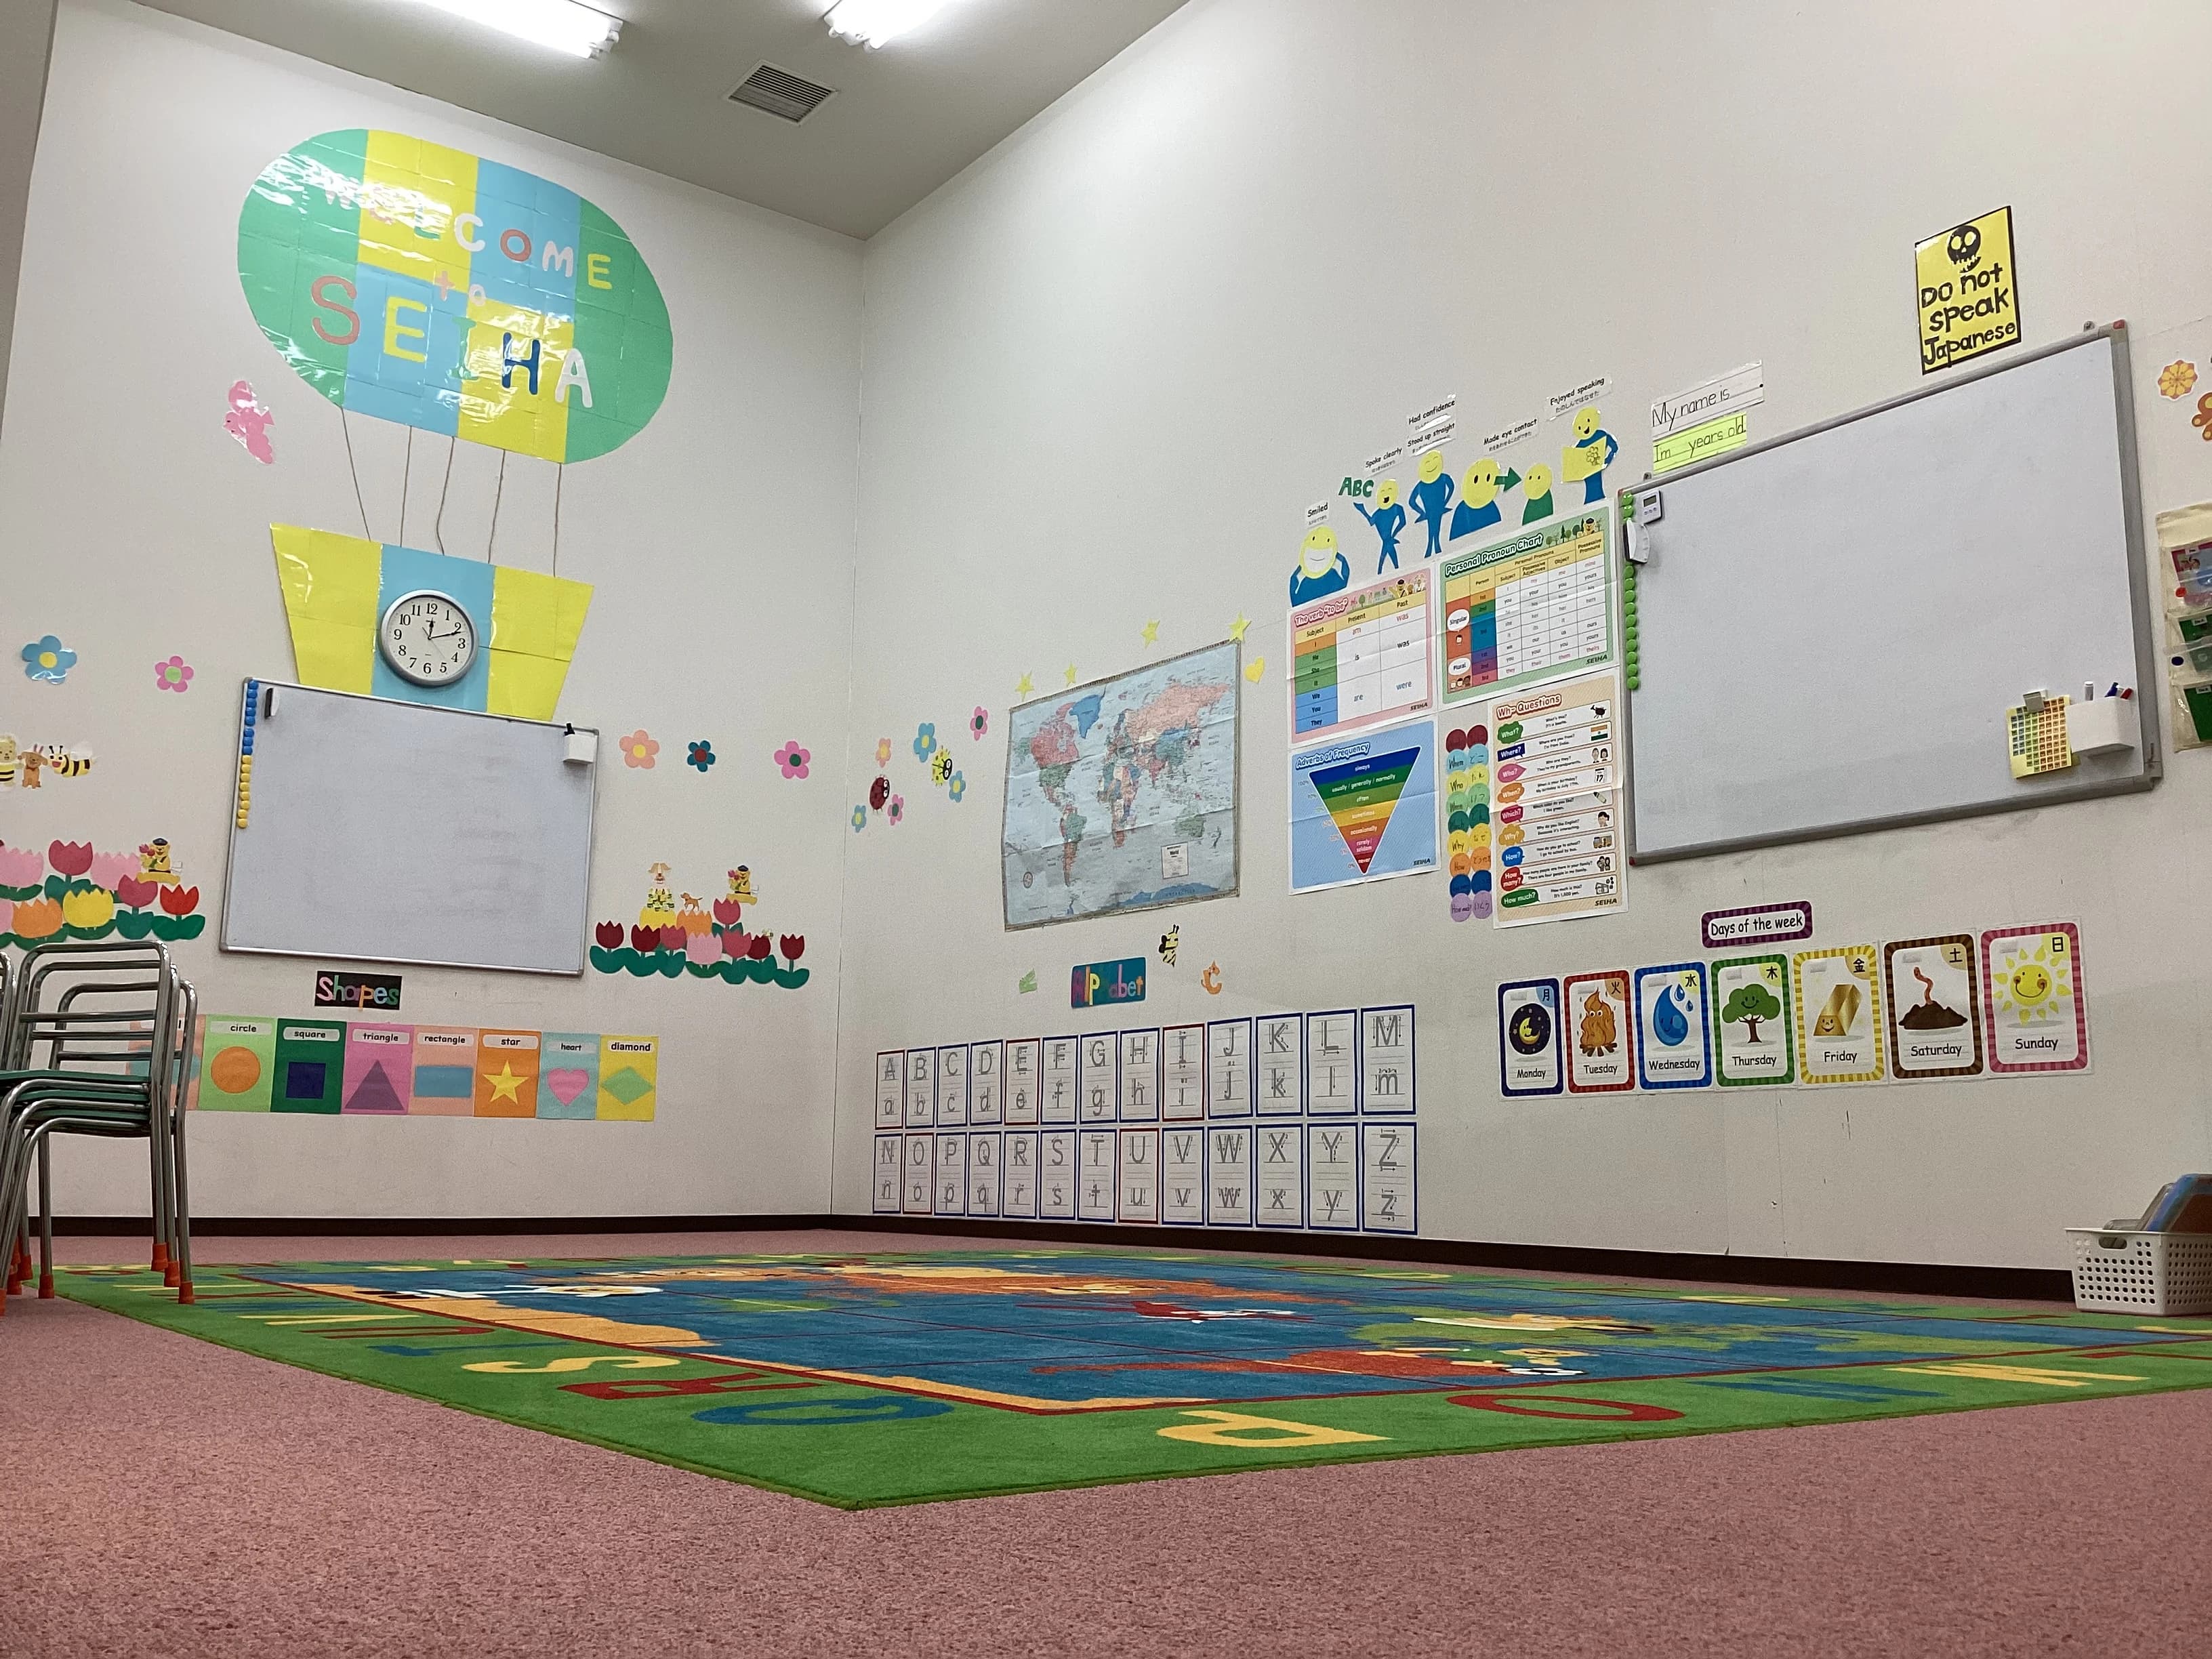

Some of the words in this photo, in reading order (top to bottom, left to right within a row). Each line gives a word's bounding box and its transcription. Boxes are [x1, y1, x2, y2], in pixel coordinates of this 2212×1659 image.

[1961, 263, 2003, 294] not
[434, 271, 486, 307] to
[1929, 287, 2009, 332] speak
[311, 276, 592, 407] SEIHA
[1923, 323, 2015, 367] Japanese
[1551, 389, 1574, 405] Enjoyed
[1578, 378, 1605, 394] speaking
[1409, 413, 1420, 425] Had
[1423, 400, 1455, 419] confidence
[1652, 402, 1677, 431] My
[1681, 393, 1716, 416] name
[1720, 385, 1729, 401] is
[1408, 435, 1423, 447] Stood
[1433, 423, 1455, 436] straight
[1483, 434, 1499, 445] Made
[1502, 430, 1513, 438] eye
[1514, 419, 1537, 432] contact
[1689, 430, 1723, 458] years
[1728, 415, 1746, 438] old.
[1366, 456, 1381, 468] Spoke
[1383, 447, 1403, 460] clearly
[1338, 477, 1374, 497] ABC
[1307, 503, 1328, 517] Smiled
[1446, 556, 1480, 575] Personal
[1481, 544, 1515, 563] Pronoun
[1517, 534, 1543, 550] Chart
[411, 605, 420, 616] 11
[426, 603, 438, 615] 12
[1397, 600, 1408, 608] Past
[400, 614, 411, 626] 10
[446, 610, 450, 621] 1
[1295, 615, 1309, 626] The
[1309, 609, 1324, 619] verb
[1348, 613, 1366, 623] Present
[1397, 614, 1408, 622] was
[394, 629, 402, 640] 9
[454, 622, 461, 633] 2
[1307, 627, 1324, 637] Subject
[398, 645, 407, 656] 8
[458, 638, 466, 649] 3
[1397, 640, 1410, 649] was
[409, 657, 417, 668] 7
[451, 652, 458, 663] 4
[1586, 655, 1607, 664] SEIHA
[423, 663, 431, 674] 6
[440, 663, 447, 672] 5
[1396, 682, 1412, 691] were
[1410, 702, 1428, 712] SEIHA
[1517, 695, 1561, 713] Questions
[1502, 728, 1519, 739] What?
[1297, 754, 1324, 768] Adverbs
[1325, 751, 1332, 760] of
[1334, 743, 1370, 760] Frequency
[1500, 747, 1521, 758] Where?
[1502, 769, 1517, 778] Who?
[1450, 779, 1463, 792] Who
[1502, 788, 1520, 798] When?
[1502, 809, 1521, 819] Which?
[1504, 832, 1519, 840] Why?
[1452, 839, 1464, 852] Why
[1506, 852, 1521, 861] How?
[1503, 877, 1521, 886] many?
[1518, 891, 1536, 900] much?
[1711, 922, 1735, 938] Days
[1738, 919, 1750, 933] of
[1753, 916, 1771, 931] the
[1774, 914, 1803, 928] week
[2052, 937, 2064, 952] 日
[1949, 948, 1963, 964] 土
[1766, 966, 1778, 980] 木
[1853, 958, 1866, 973] 金
[1072, 965, 1143, 1006] Alpabet
[1612, 981, 1620, 995] 火
[1686, 975, 1697, 987] 水
[316, 975, 400, 1011] Shapes
[1542, 988, 1551, 1002] 月
[230, 1023, 258, 1033] circle
[294, 1030, 326, 1040] square
[1324, 1019, 1339, 1050] L
[1376, 1015, 1398, 1046] M
[363, 1032, 398, 1042] triangle
[424, 1034, 466, 1045] rectangle
[501, 1037, 520, 1046] star
[1224, 1027, 1235, 1057] J
[1271, 1023, 1287, 1052] K
[2015, 1037, 2059, 1052] Sunday
[561, 1042, 581, 1052] heart
[611, 1042, 651, 1052] diamond
[1091, 1040, 1105, 1067] G
[1132, 1037, 1146, 1064] H
[1179, 1036, 1186, 1063] I
[1911, 1044, 1962, 1058] Saturday
[947, 1052, 958, 1076] C
[980, 1050, 992, 1075] D
[1017, 1046, 1027, 1071] E
[1055, 1044, 1066, 1069] F
[1649, 1057, 1700, 1071] Wednesday
[1732, 1054, 1777, 1068] Thursday
[1824, 1050, 1857, 1064] Friday
[885, 1058, 895, 1080] A
[915, 1057, 927, 1080] B
[1517, 1067, 1547, 1080] Monday
[1584, 1063, 1618, 1075] Tuesday
[882, 1140, 893, 1164] N
[913, 1141, 924, 1166] O
[946, 1140, 957, 1166] P
[978, 1141, 991, 1166] Q
[1016, 1139, 1027, 1166] R
[1052, 1139, 1064, 1166] S
[1091, 1139, 1105, 1166] T
[1130, 1136, 1146, 1164] U
[1175, 1135, 1191, 1163] V
[1219, 1133, 1240, 1163] W
[1269, 1132, 1287, 1162] X
[1323, 1132, 1340, 1163] Y
[1378, 1134, 1397, 1166] Z
